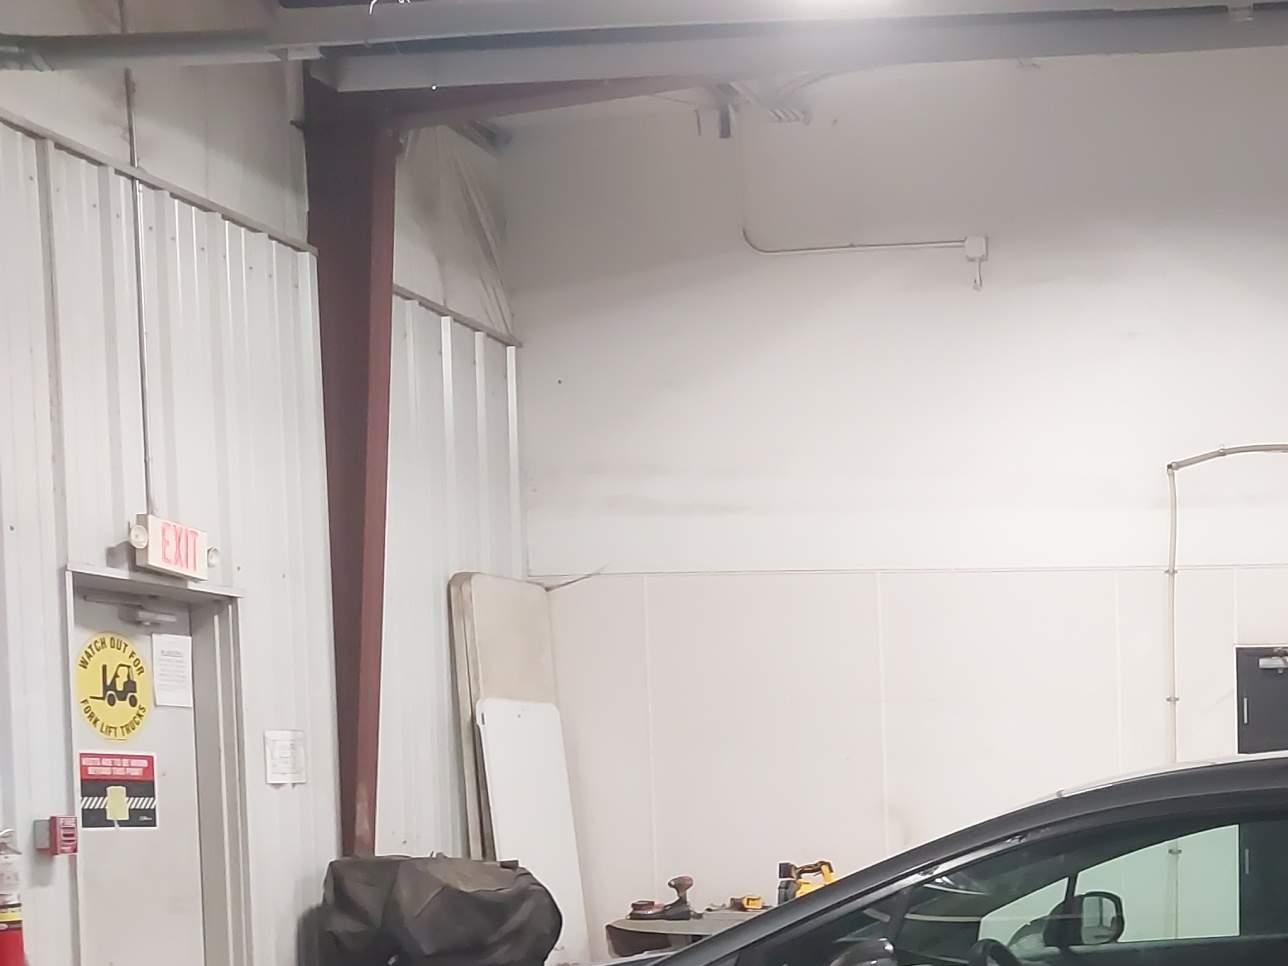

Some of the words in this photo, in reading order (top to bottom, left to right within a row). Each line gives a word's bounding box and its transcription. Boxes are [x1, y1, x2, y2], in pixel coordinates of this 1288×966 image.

[161, 522, 199, 572] EXIT
[78, 637, 107, 669] WATCH
[110, 636, 128, 653] OUT
[128, 650, 145, 676] FOR
[80, 698, 101, 728] FORK
[100, 722, 118, 738] LIFT
[119, 704, 147, 737] TRUCKS
